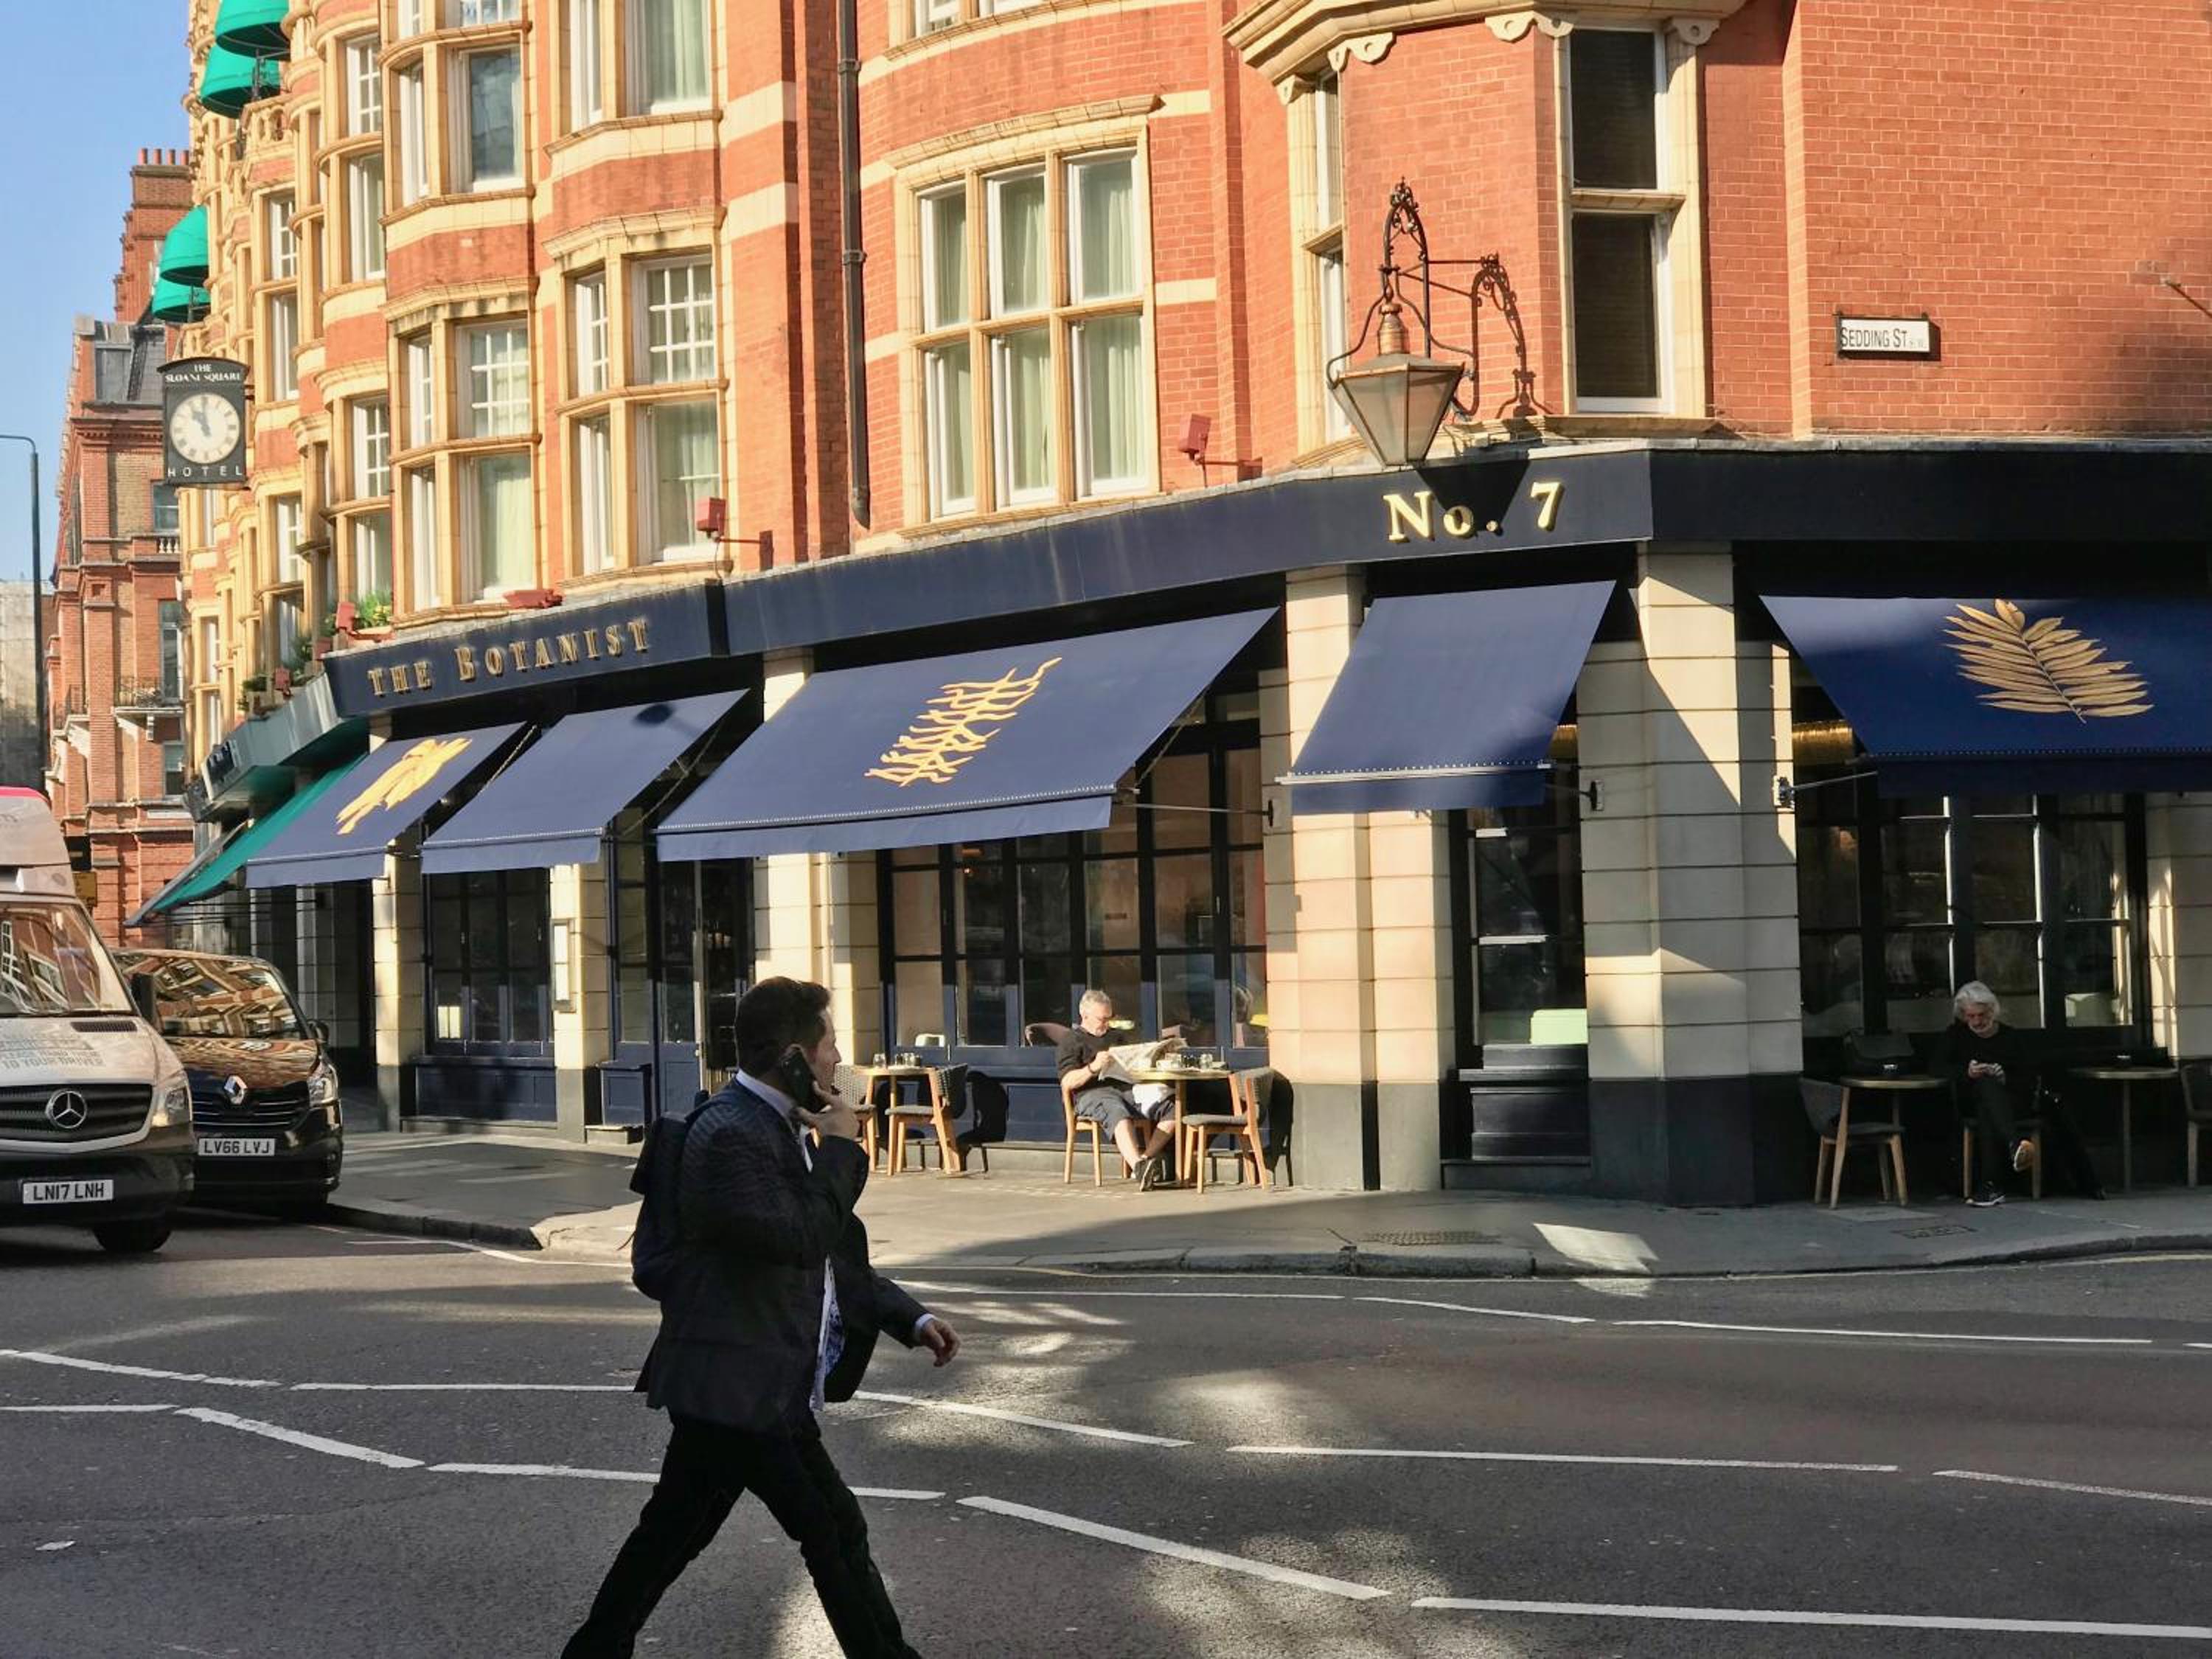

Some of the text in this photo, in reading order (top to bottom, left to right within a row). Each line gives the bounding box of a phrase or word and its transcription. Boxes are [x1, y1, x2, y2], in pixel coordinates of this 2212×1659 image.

[1840, 327, 1890, 347] SEDDING
[194, 364, 212, 372] THE
[167, 465, 243, 478] HOTEL
[1383, 481, 1564, 543] No. 7
[367, 619, 649, 697] THE BOTANIST
[204, 1140, 270, 1154] LV66 LVJ
[33, 1182, 105, 1201] LN17 LNH
